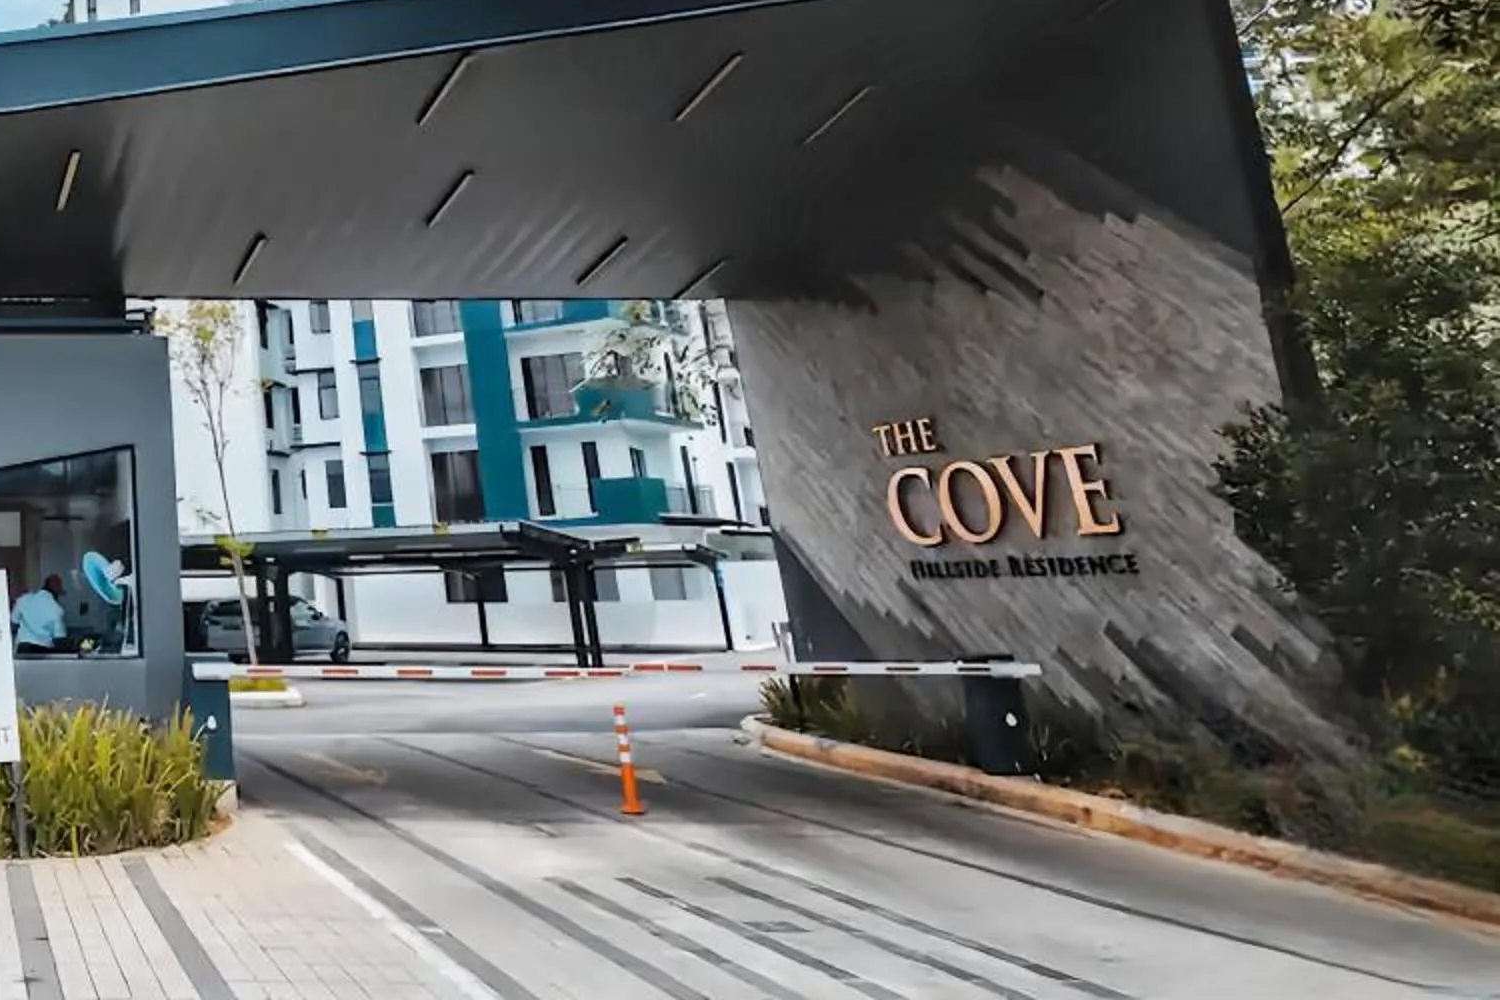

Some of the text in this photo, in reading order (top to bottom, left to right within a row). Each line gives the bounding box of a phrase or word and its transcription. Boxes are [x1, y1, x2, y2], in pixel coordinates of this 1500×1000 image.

[871, 417, 937, 457] THE
[887, 443, 1121, 546] COVE
[910, 554, 1140, 581] HILLSIDE RESIDENCE
